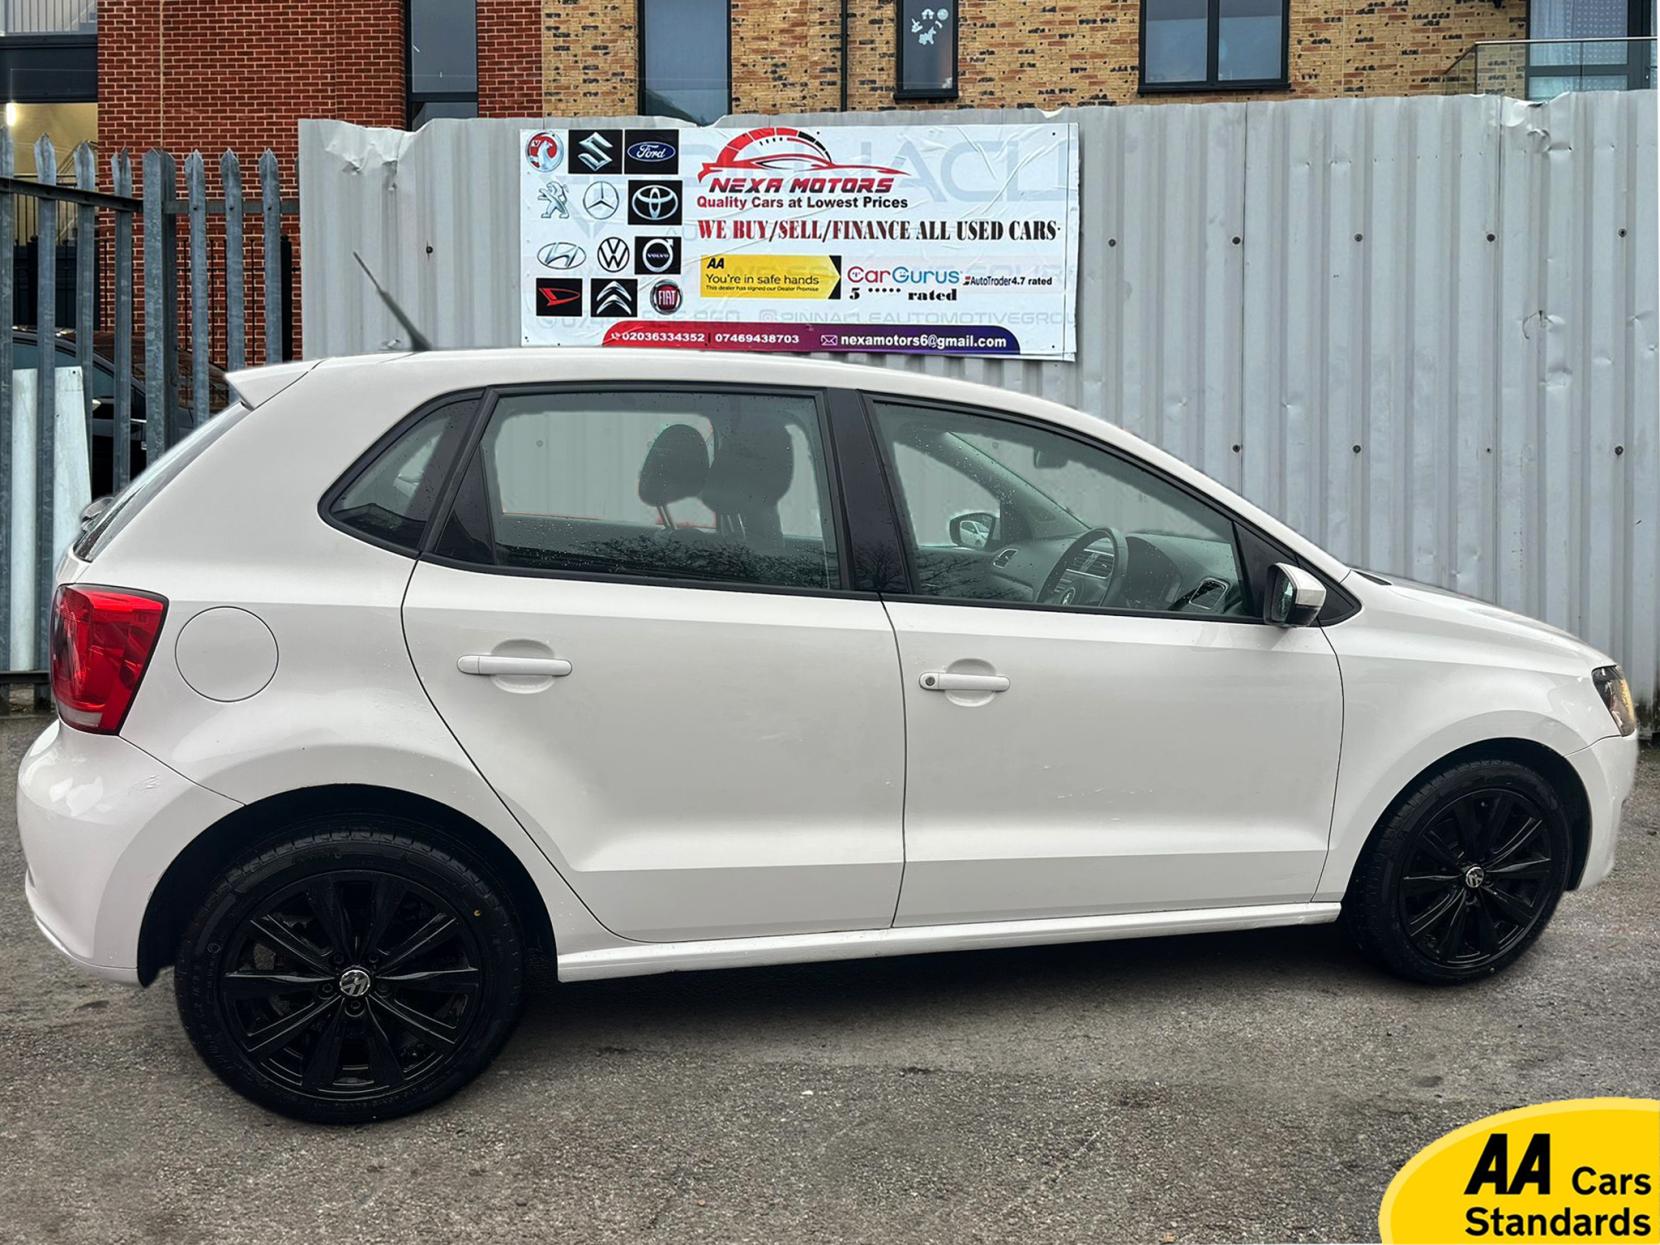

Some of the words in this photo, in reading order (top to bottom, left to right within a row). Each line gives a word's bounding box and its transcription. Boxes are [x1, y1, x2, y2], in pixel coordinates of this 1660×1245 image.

[635, 144, 667, 159] Ford
[709, 178, 783, 194] NEXA
[795, 178, 894, 194] MOTORS
[697, 196, 747, 210] Quality
[751, 196, 784, 208] Cars
[788, 197, 803, 208] at
[807, 197, 859, 208] Lowest
[863, 197, 908, 208] Prices
[697, 220, 727, 240] WE
[733, 220, 910, 243] BUY/SELL/FINANCE
[916, 221, 950, 240] ALL
[957, 221, 1004, 240] USED
[706, 257, 725, 269] AA
[705, 273, 741, 284] You're
[744, 273, 754, 284] in
[757, 274, 781, 285] safe
[784, 275, 819, 285] hands
[847, 266, 960, 284] CarGurus
[1028, 277, 1053, 286] rated
[658, 290, 676, 305] FIAT
[849, 287, 860, 301] 5
[908, 289, 957, 301] rated
[622, 332, 705, 342] 02036334352
[715, 332, 800, 343] 07469438703
[841, 335, 1007, 349] nexamotors6@gmail.com
